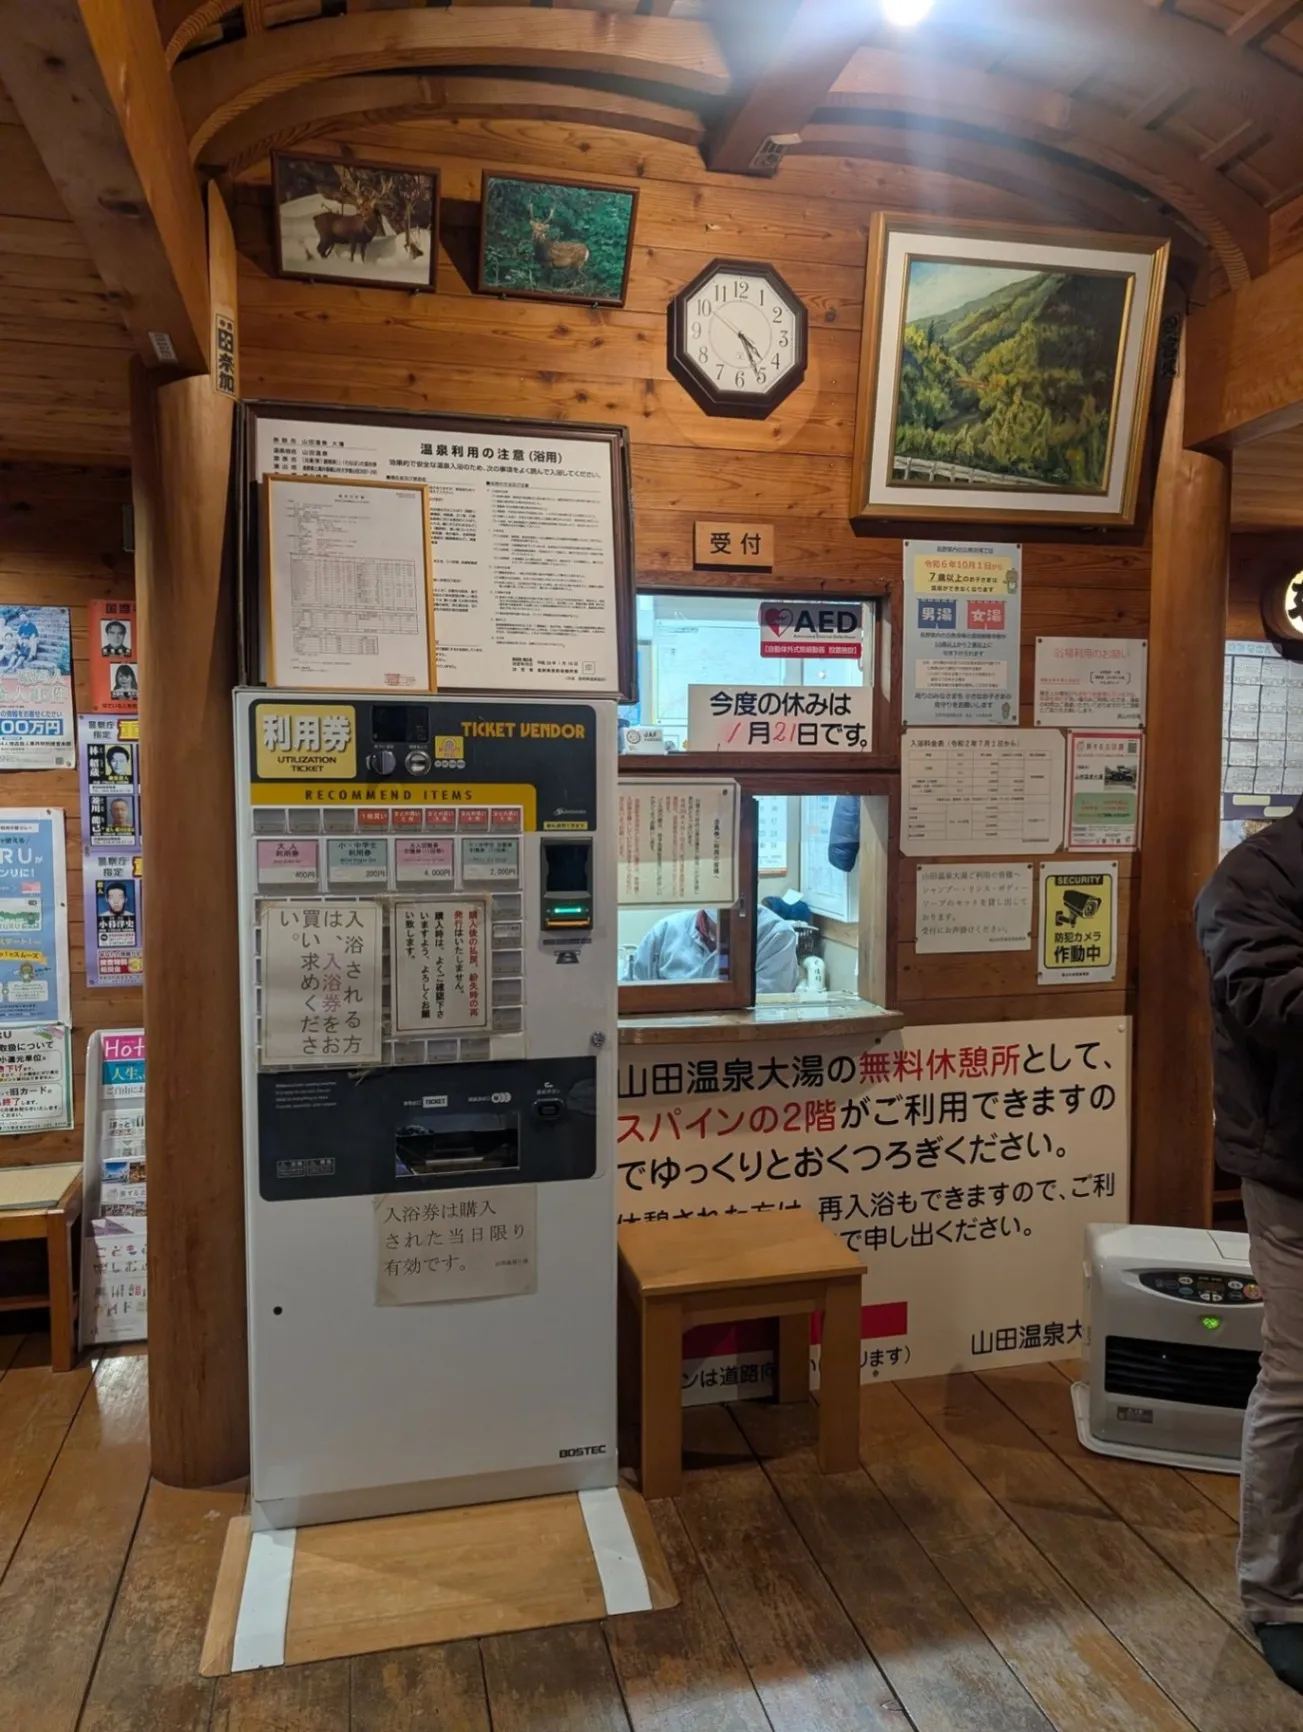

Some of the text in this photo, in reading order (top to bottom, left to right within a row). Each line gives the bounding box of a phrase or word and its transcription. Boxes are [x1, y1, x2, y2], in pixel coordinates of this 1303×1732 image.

[714, 284, 727, 302] 11
[734, 281, 749, 299] 12
[760, 290, 764, 306] 1
[697, 299, 712, 317] 10
[772, 307, 782, 324] 2
[691, 322, 701, 339] 9
[779, 330, 789, 347] 3
[698, 347, 708, 364] 8
[771, 353, 780, 370] 4
[716, 364, 724, 380] 7
[735, 370, 745, 388] 6
[756, 368, 767, 384] 5
[709, 532, 761, 556] 受付
[794, 610, 858, 633] AED
[922, 607, 952, 622] 男湯
[971, 608, 1001, 622] 女湯
[710, 691, 851, 717] 今度の休みは
[263, 714, 352, 753] 利用券
[461, 721, 585, 739] TICKET VENDOR
[277, 756, 337, 764] UTILIZATION
[290, 765, 324, 773] TICKET
[304, 789, 474, 801] RECOMMEND ITEMS
[1057, 876, 1101, 885] SECURITY
[280, 911, 300, 942] い。
[1054, 931, 1101, 943] 防犯カメラ
[1054, 945, 1101, 964] 作動中
[301, 909, 321, 1055] 買い求めくださ
[321, 910, 342, 1055] は、入浴券をお
[343, 910, 364, 1055] 入浴される方
[617, 1042, 1112, 1099] 山田温泉大湯の無料休憩所として、
[617, 1084, 1116, 1143] スパインの2階がご利用できますの
[617, 1132, 1066, 1191] でゆっくりとおくつろぎください。
[818, 1172, 1115, 1222] 再入浴もできますので、ご利
[383, 1200, 498, 1223] 入浴券は購入
[384, 1223, 526, 1249] された当日限り
[840, 1216, 1032, 1252] で申し出ください。
[384, 1254, 467, 1277] 有効です。
